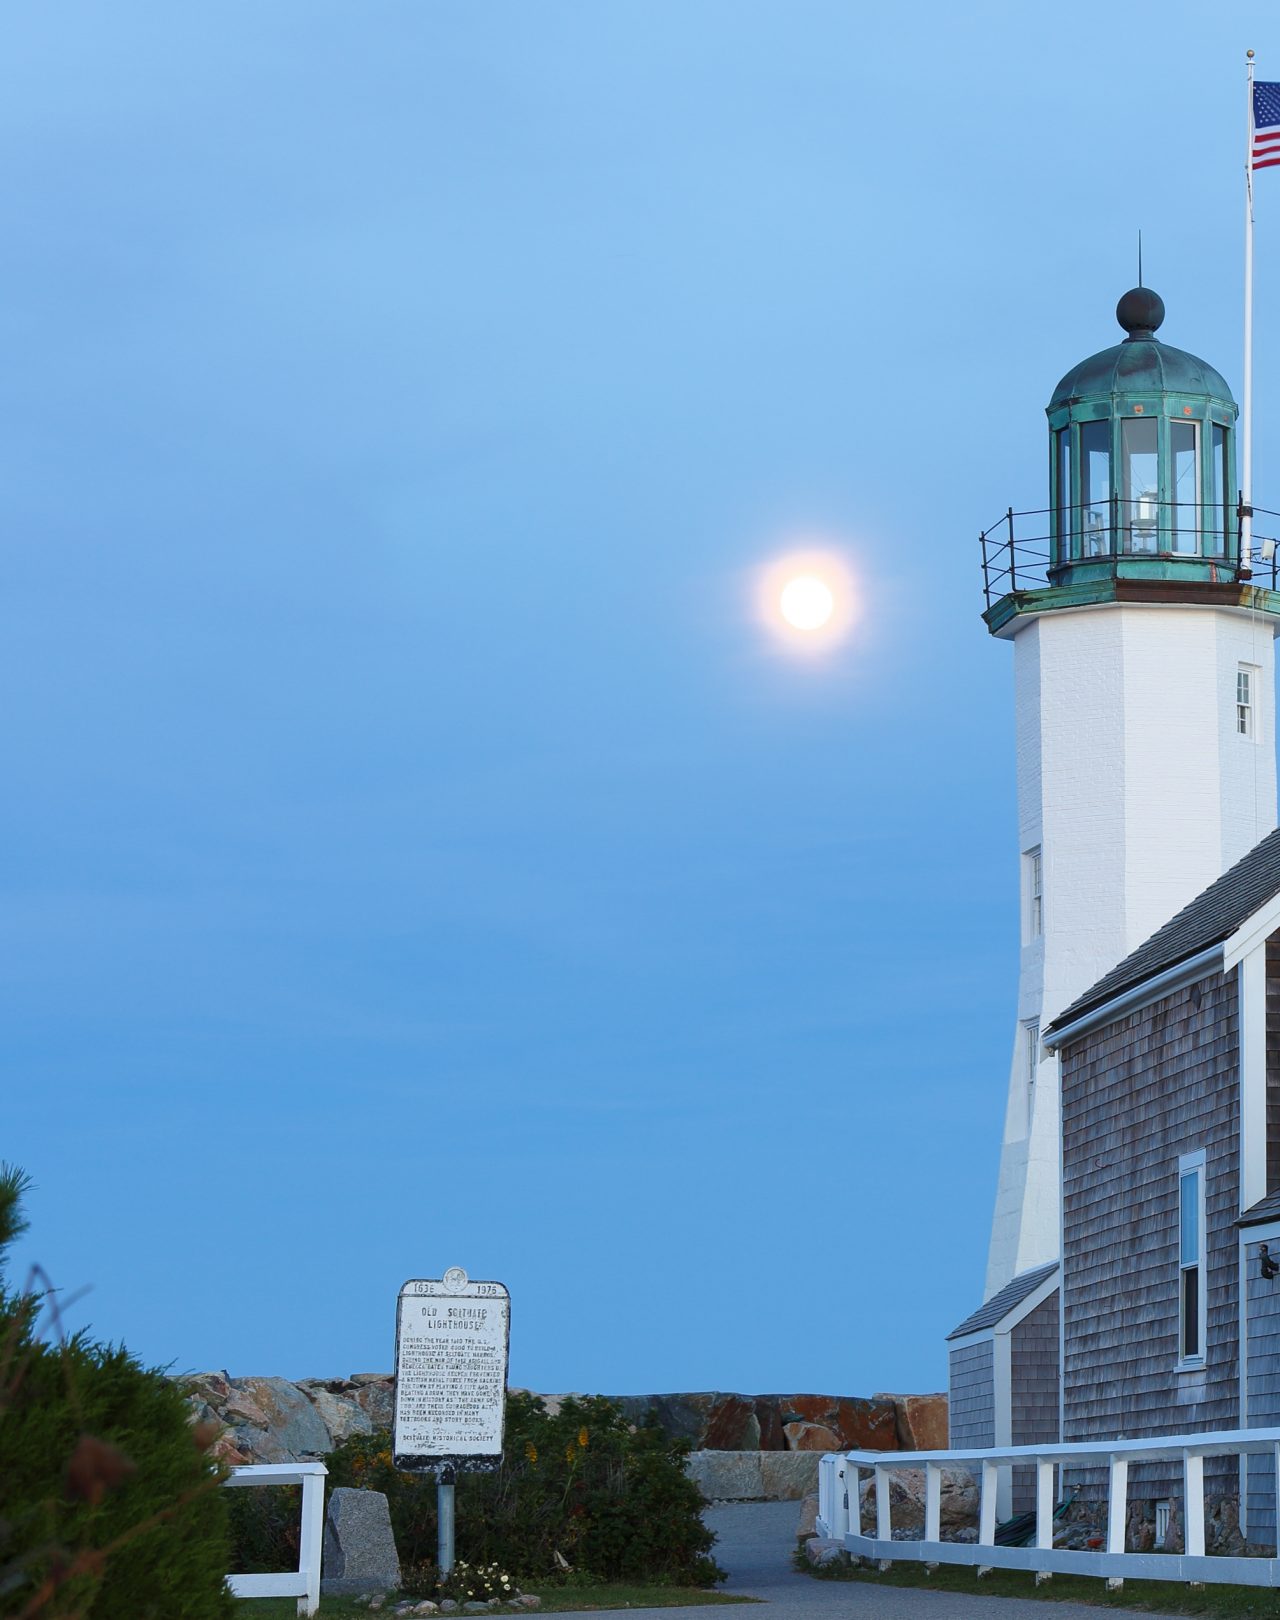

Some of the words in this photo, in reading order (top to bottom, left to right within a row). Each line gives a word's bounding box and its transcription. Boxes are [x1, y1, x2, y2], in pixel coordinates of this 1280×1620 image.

[477, 1285, 497, 1295] 1976
[421, 1307, 438, 1317] OLD
[428, 1319, 481, 1331] LIGHTHOUSE
